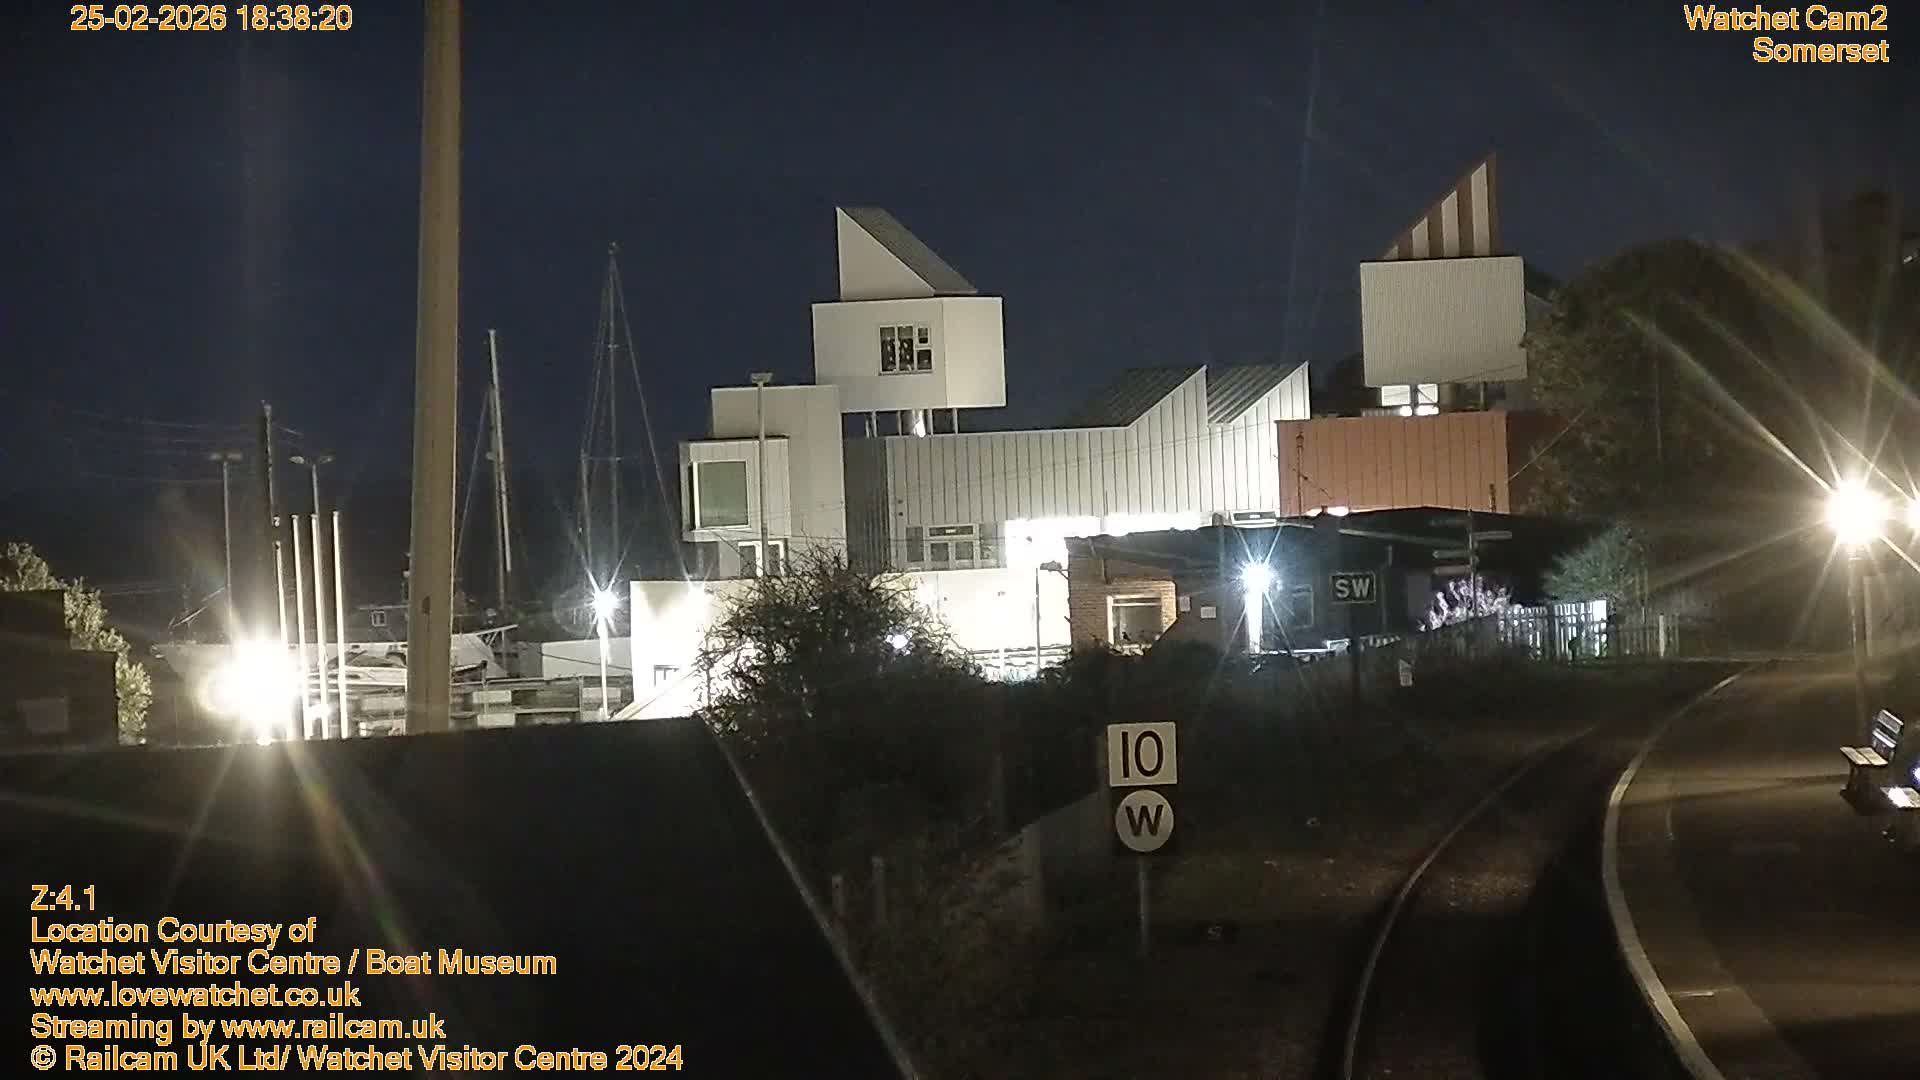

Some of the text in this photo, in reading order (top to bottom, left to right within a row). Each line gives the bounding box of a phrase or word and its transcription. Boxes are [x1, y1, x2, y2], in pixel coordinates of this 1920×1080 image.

[1335, 578, 1371, 599] SW
[1121, 730, 1164, 778] 10
[1125, 804, 1164, 836] W
